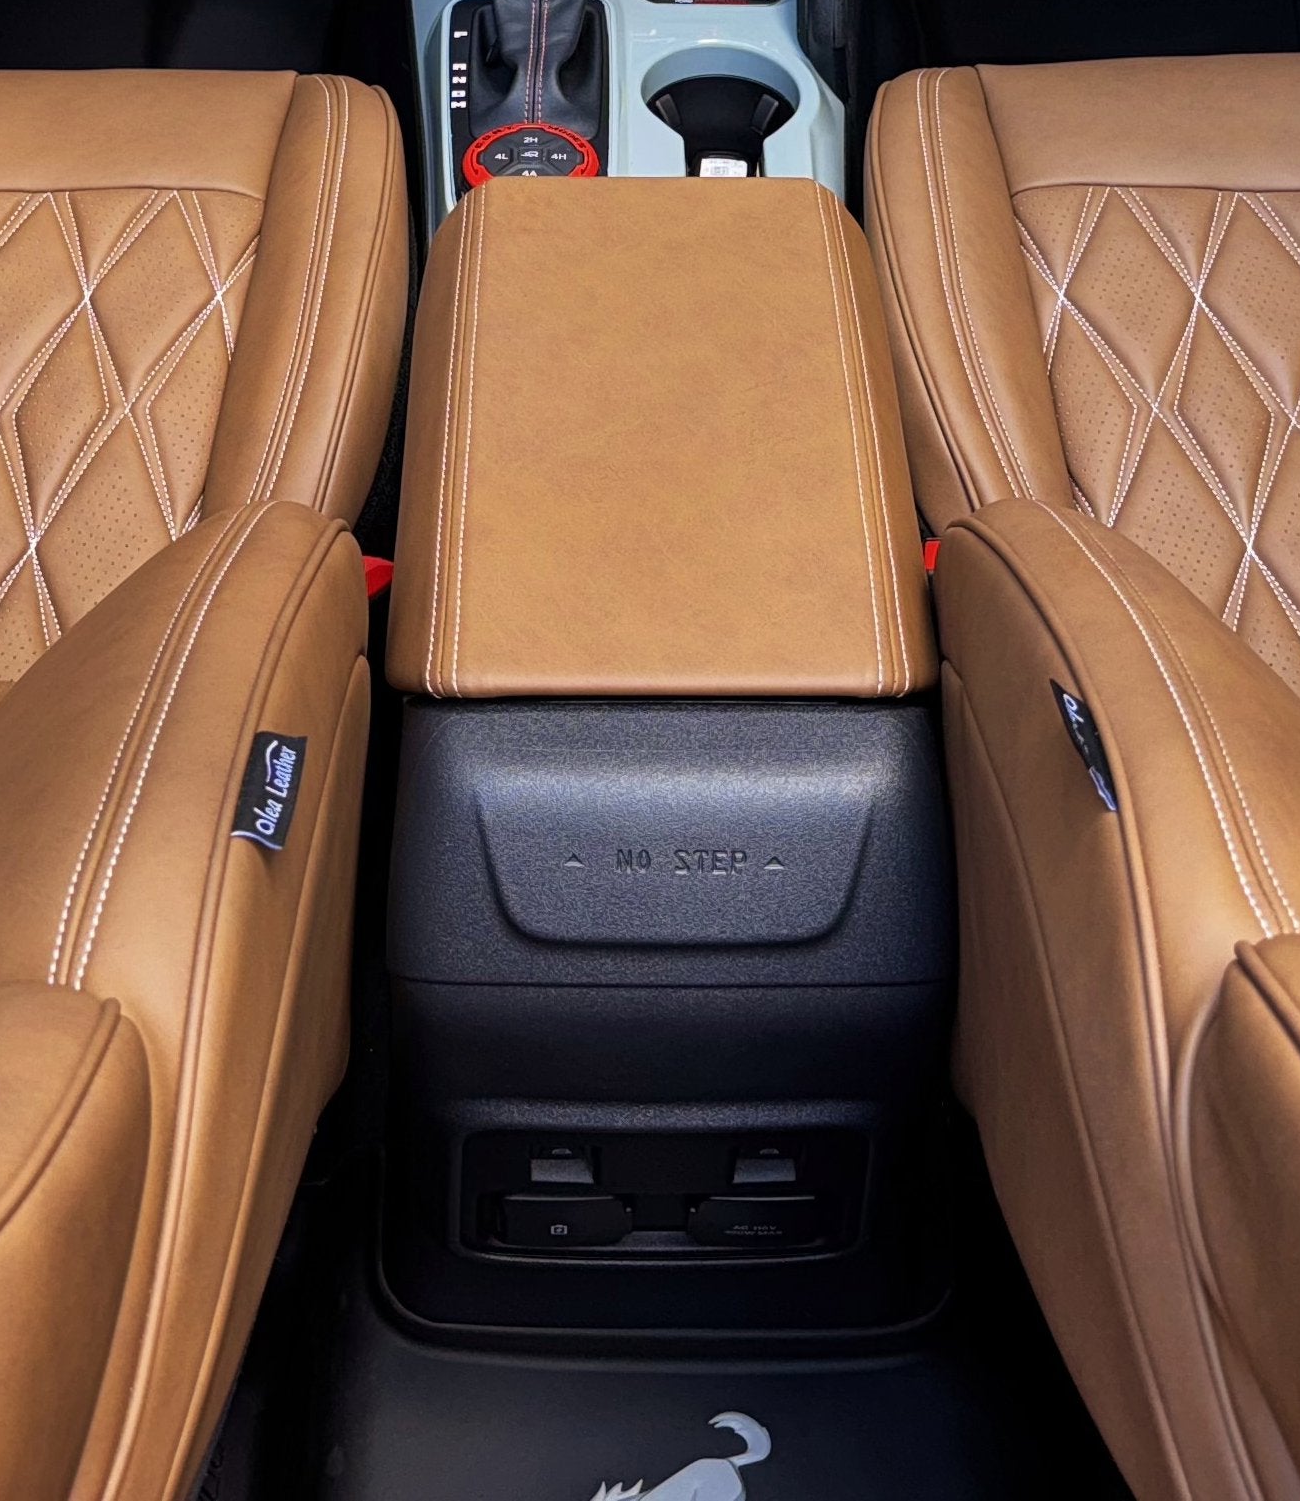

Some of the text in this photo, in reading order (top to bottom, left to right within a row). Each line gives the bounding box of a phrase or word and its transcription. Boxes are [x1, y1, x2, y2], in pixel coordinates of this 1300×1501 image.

[452, 76, 467, 84] N
[451, 90, 466, 98] D
[451, 101, 467, 109] M
[265, 745, 297, 797] Leather
[616, 849, 747, 875] NO STEP
